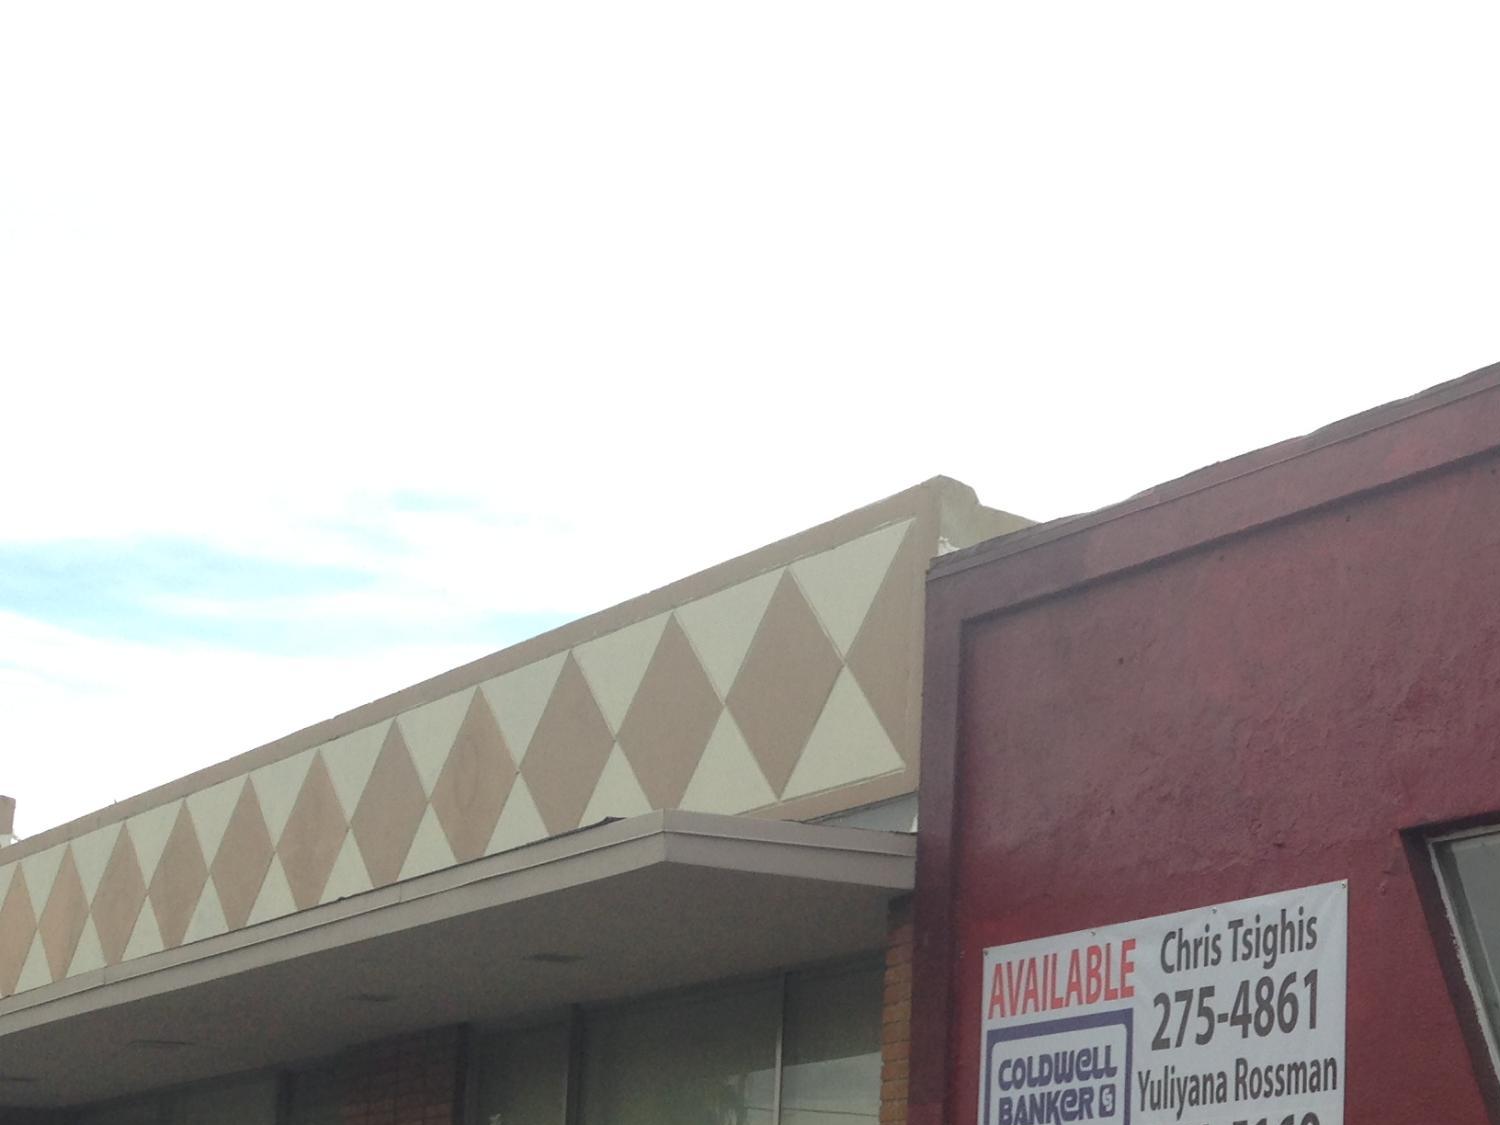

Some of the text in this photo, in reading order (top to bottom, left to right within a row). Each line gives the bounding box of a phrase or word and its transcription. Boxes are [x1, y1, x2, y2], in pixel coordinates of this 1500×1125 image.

[1160, 905, 1318, 975] Chris Tsighis
[987, 937, 1137, 1020] AVAILABLE
[1150, 968, 1319, 1051] 275-4861
[1137, 1055, 1338, 1121] Yuliyana Rossman
